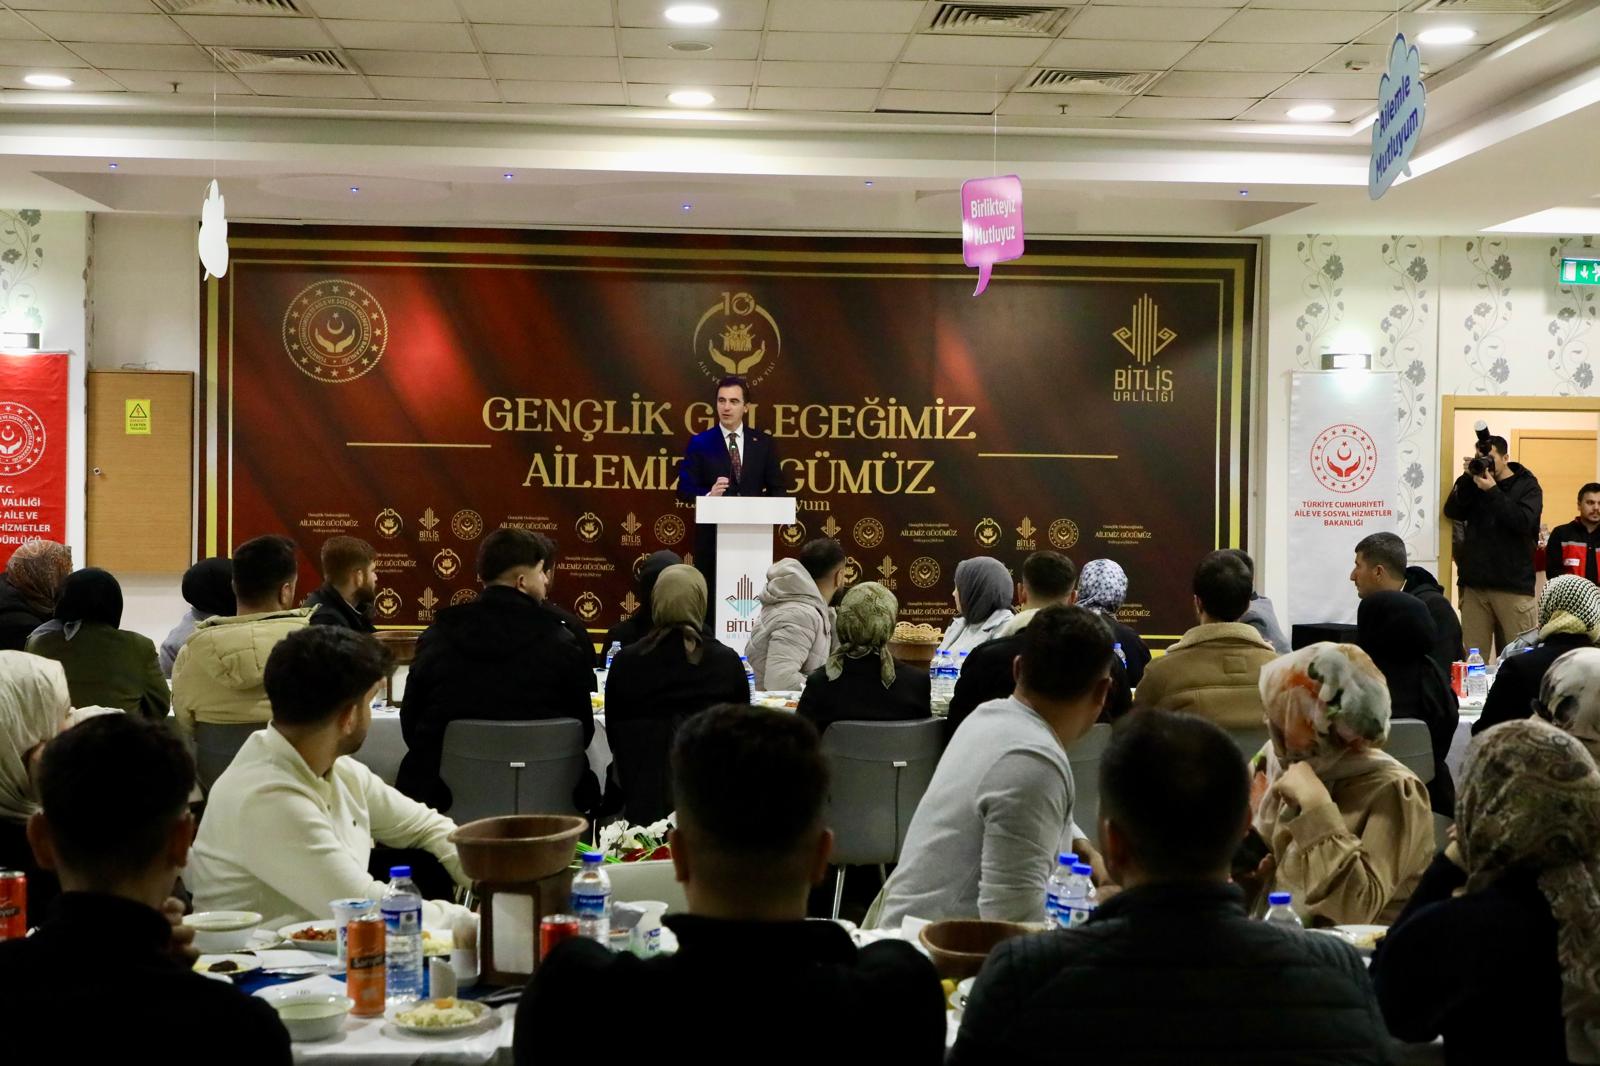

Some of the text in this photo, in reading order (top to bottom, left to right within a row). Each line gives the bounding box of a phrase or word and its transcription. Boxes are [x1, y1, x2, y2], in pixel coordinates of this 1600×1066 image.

[1379, 75, 1411, 137] Ailemle
[1376, 107, 1419, 183] Mutluyum
[970, 198, 1016, 219] Birlikteyiz
[974, 225, 1015, 245] Mutluyuz
[721, 291, 755, 316] 10
[1114, 365, 1174, 391] BİTLİS
[482, 392, 977, 442] GENÇLİK GLECEĞİMİZ
[2, 498, 41, 507] VALİLİĞİ
[1302, 500, 1384, 508] TÜRKİYE CUMHURİYETİ
[4, 510, 38, 519] AİLE VE
[1294, 509, 1310, 517] AİLE
[1323, 509, 1350, 517] SOSYAL
[1352, 509, 1392, 517] HİZMETLER
[419, 530, 439, 538] BİTLİS
[621, 534, 641, 543] BİTLİS
[1016, 538, 1036, 547] BİTLİS
[726, 618, 755, 633] BİTLİ
